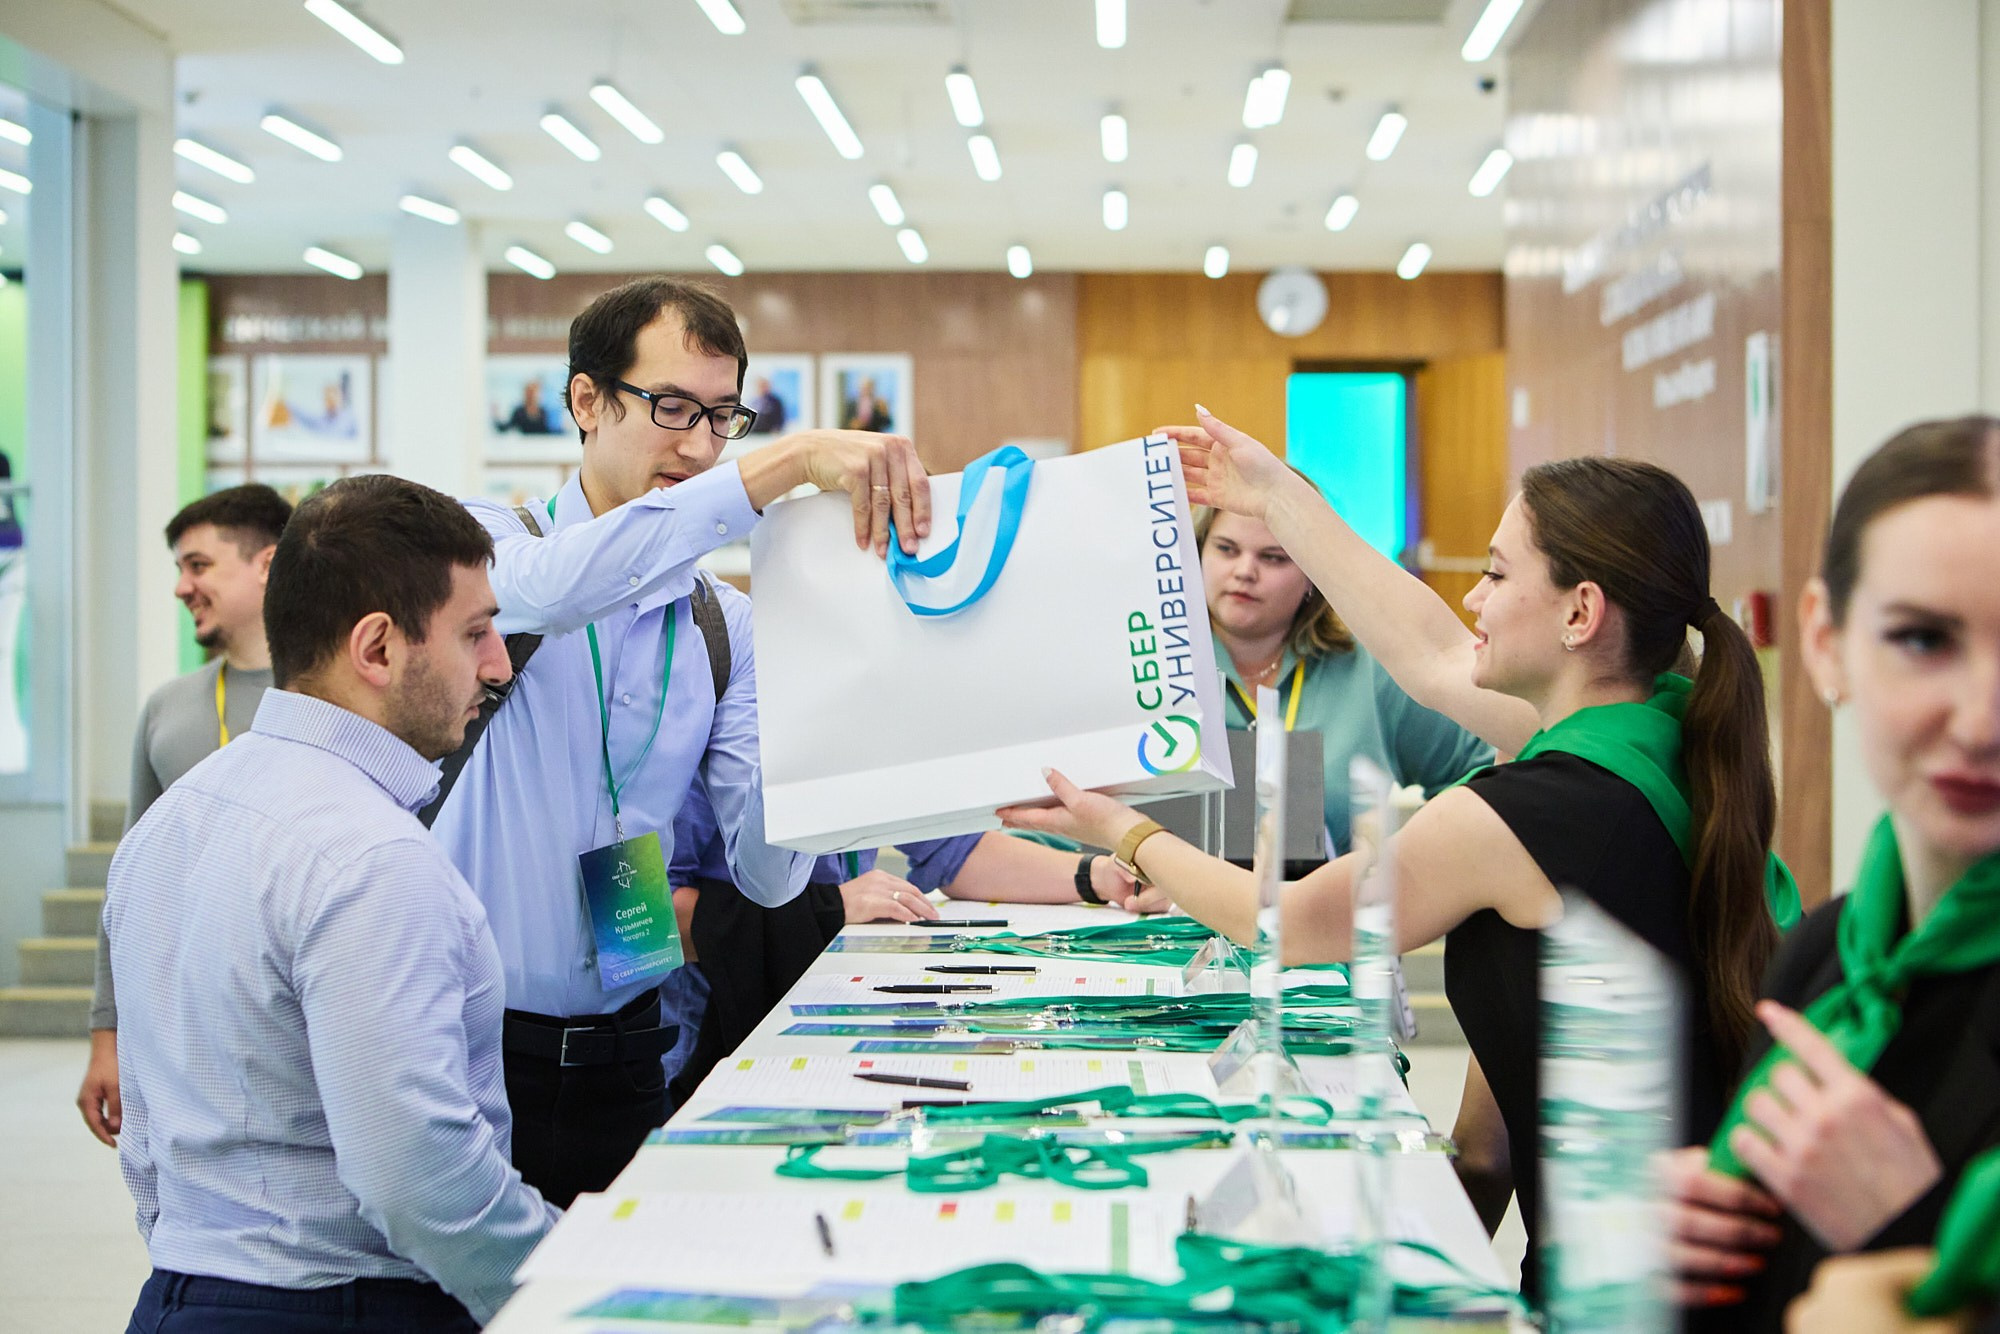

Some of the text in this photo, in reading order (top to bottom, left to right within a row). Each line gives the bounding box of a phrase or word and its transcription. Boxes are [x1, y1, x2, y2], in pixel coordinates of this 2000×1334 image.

[1143, 437, 1196, 707] УНИВЕРСИТЕТ
[1128, 610, 1163, 711] СБЕР
[615, 901, 648, 920] Сергей
[614, 917, 653, 934] Кузьмичев
[622, 928, 650, 943] Когорта 2
